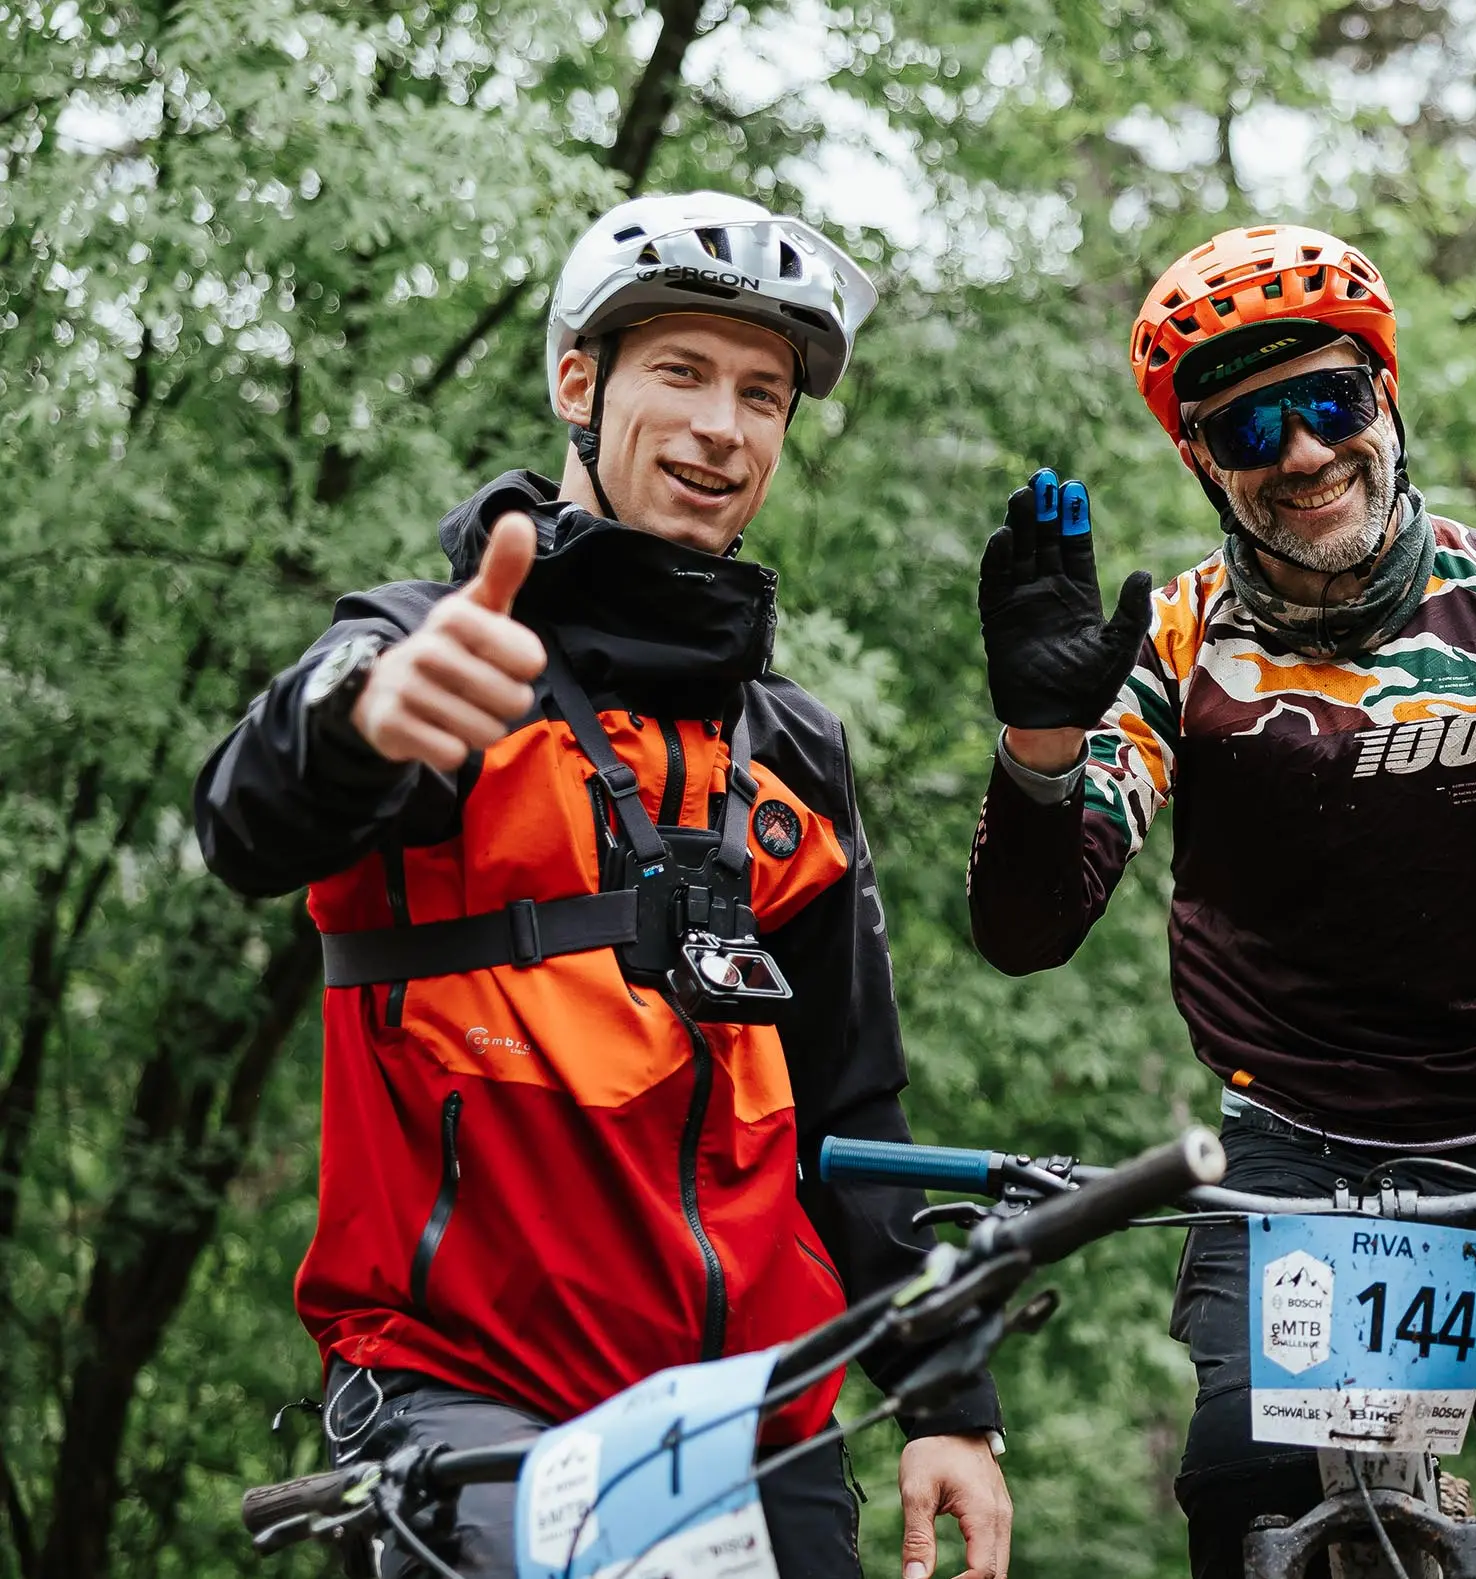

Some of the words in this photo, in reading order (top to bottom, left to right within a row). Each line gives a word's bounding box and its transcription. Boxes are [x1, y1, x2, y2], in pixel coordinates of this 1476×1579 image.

[664, 265, 759, 291] ERGON
[1352, 1232, 1413, 1259] RIVA
[1288, 1298, 1323, 1309] BOSCH
[1271, 1319, 1321, 1337] eMTB
[1356, 1281, 1476, 1363] 144
[1262, 1404, 1321, 1420] SCHWALBE
[1431, 1407, 1467, 1419] BOSCH
[660, 1416, 685, 1495] 1
